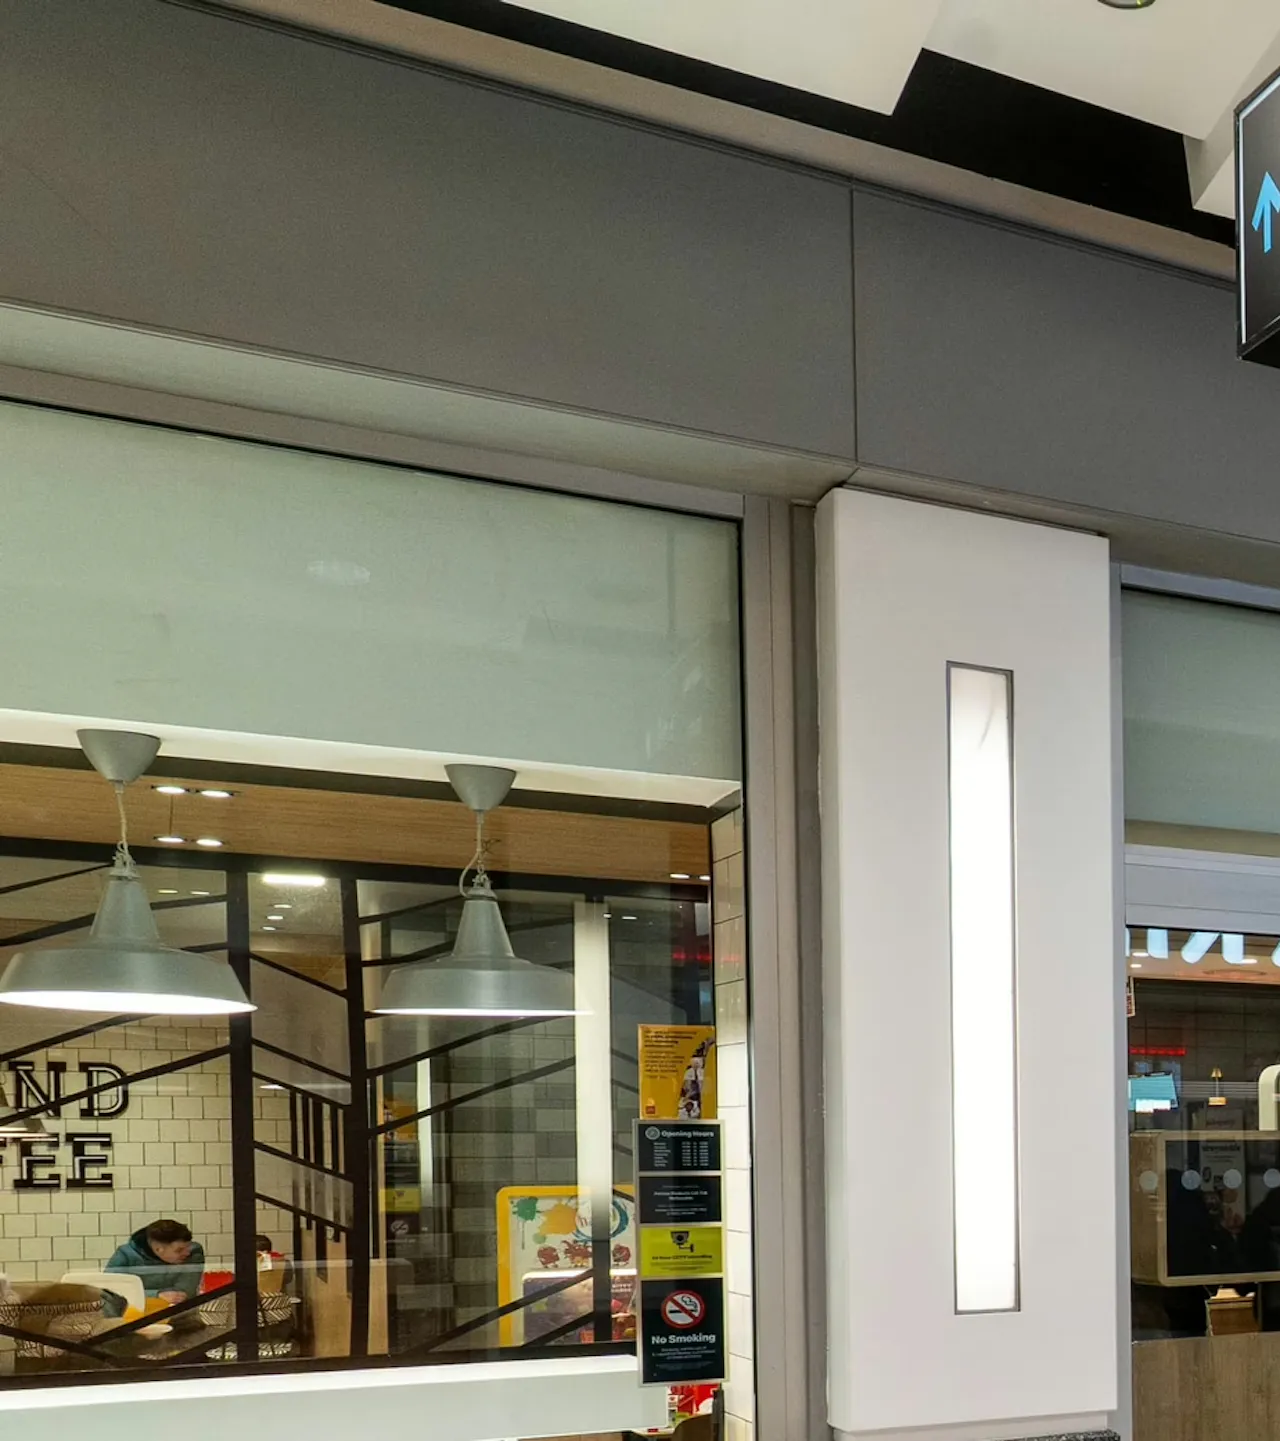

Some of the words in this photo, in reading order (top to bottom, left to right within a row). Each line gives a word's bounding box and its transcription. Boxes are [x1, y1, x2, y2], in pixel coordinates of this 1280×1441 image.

[661, 1130, 692, 1138] Opening
[0, 1133, 113, 1188] EE
[651, 1335, 667, 1344] No
[668, 1332, 716, 1344] Smoking
